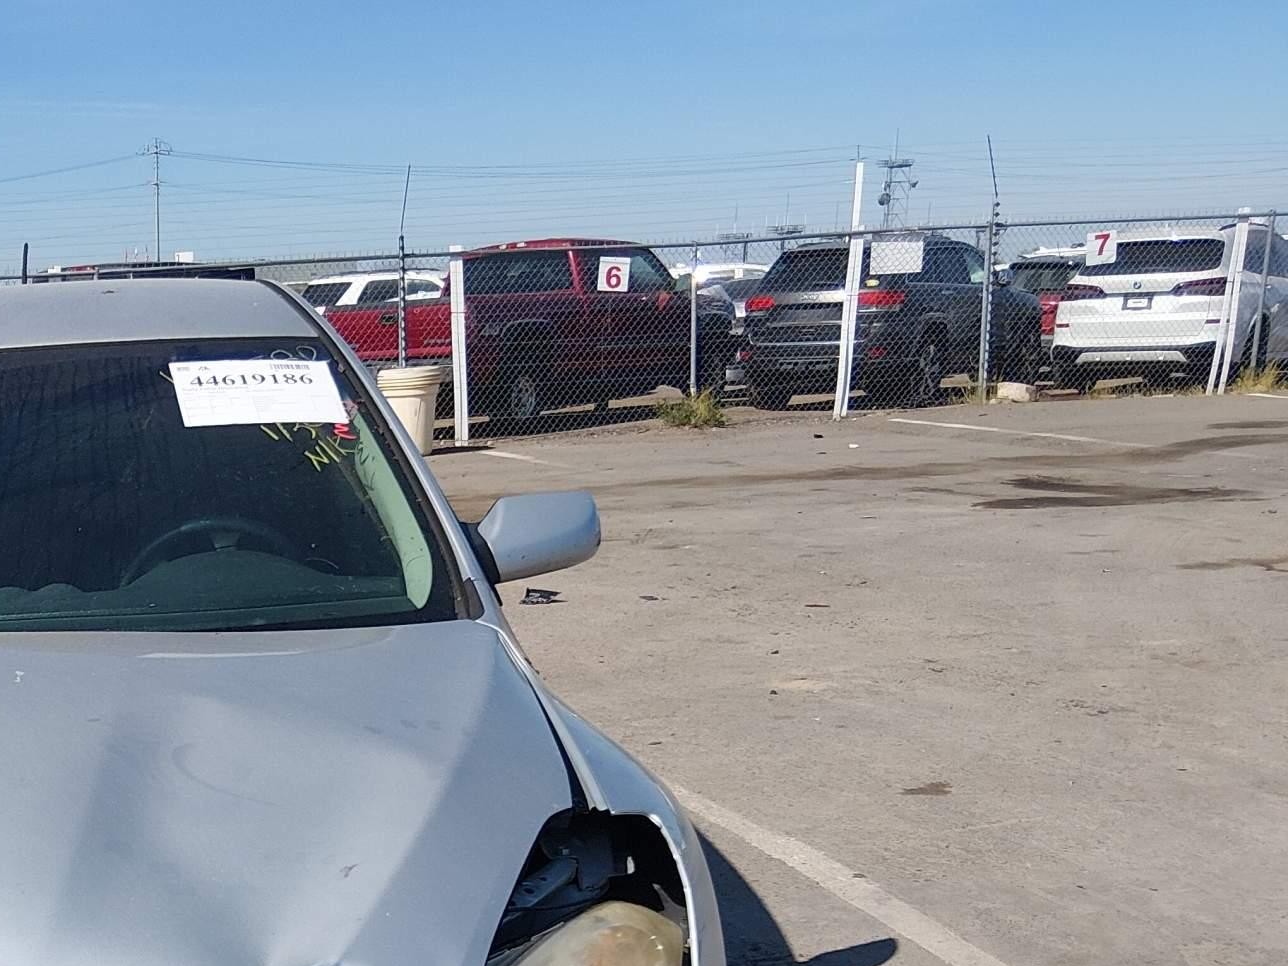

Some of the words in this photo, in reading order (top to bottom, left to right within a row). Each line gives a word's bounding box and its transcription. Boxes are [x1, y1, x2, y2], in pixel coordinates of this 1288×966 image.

[1094, 232, 1111, 256] 7
[605, 266, 622, 289] 6
[189, 373, 314, 387] 44619186
